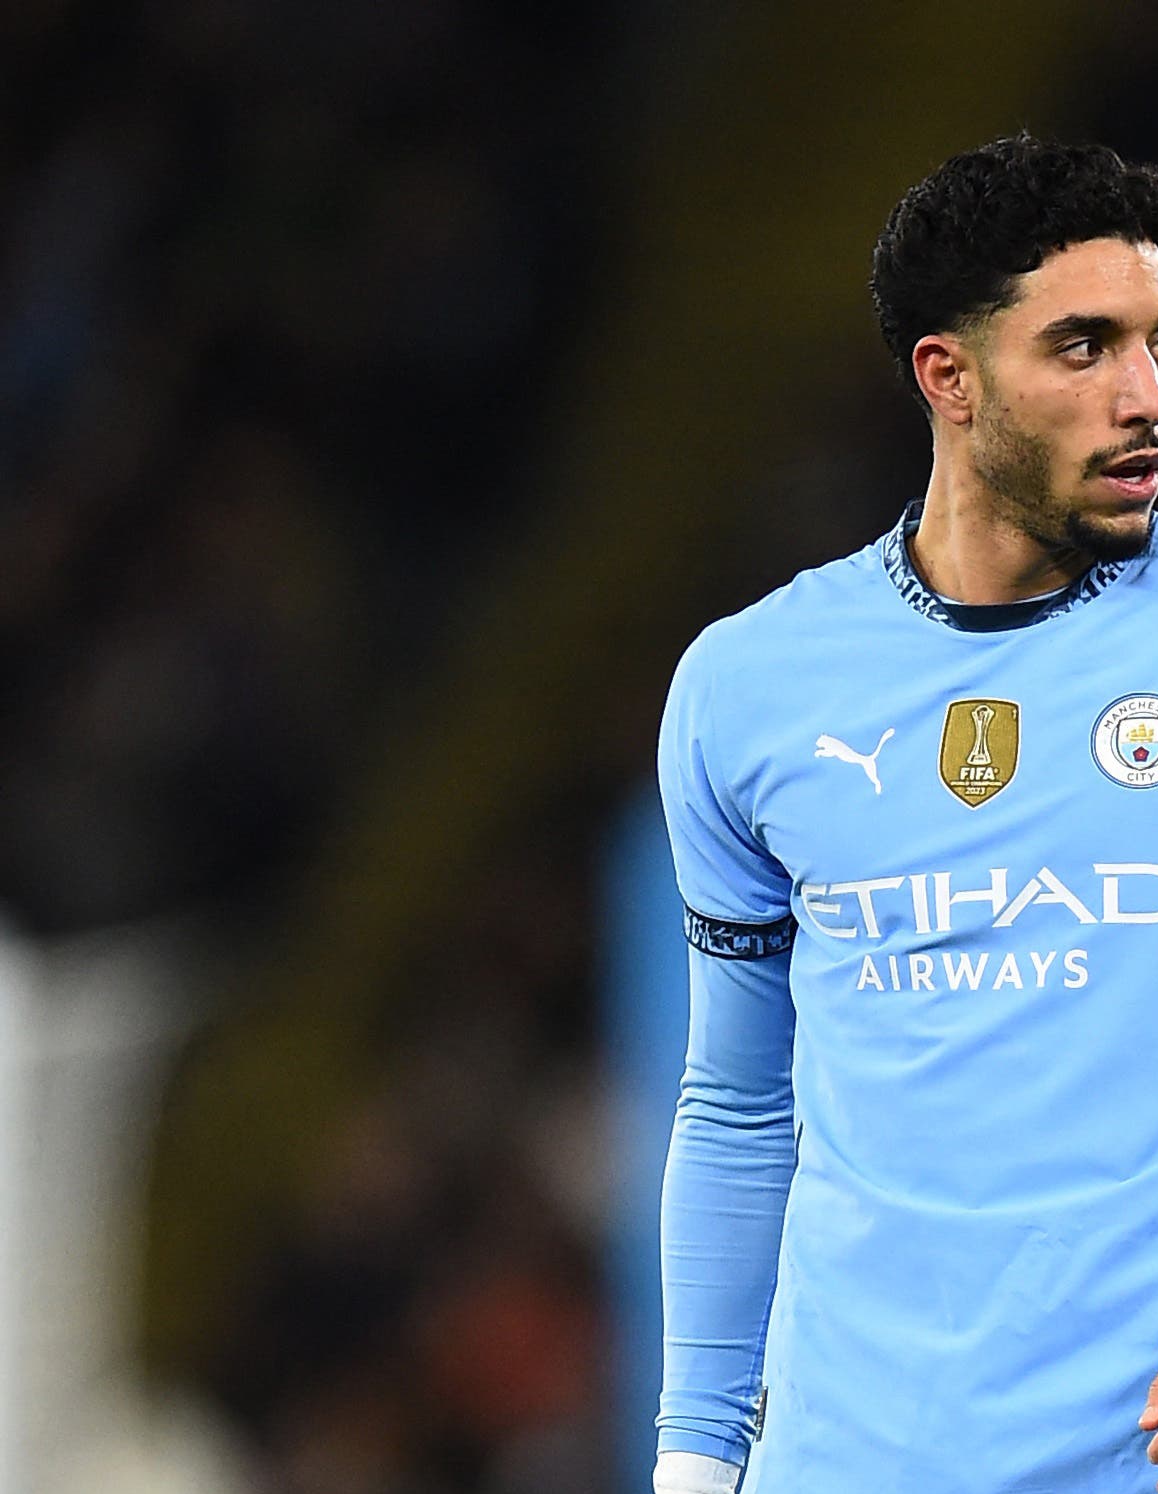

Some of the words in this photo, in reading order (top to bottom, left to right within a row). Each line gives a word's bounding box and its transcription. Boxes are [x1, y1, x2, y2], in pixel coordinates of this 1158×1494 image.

[960, 767, 996, 780] FIFA
[1127, 772, 1155, 781] CITY
[857, 950, 1089, 991] AIRWAYS
